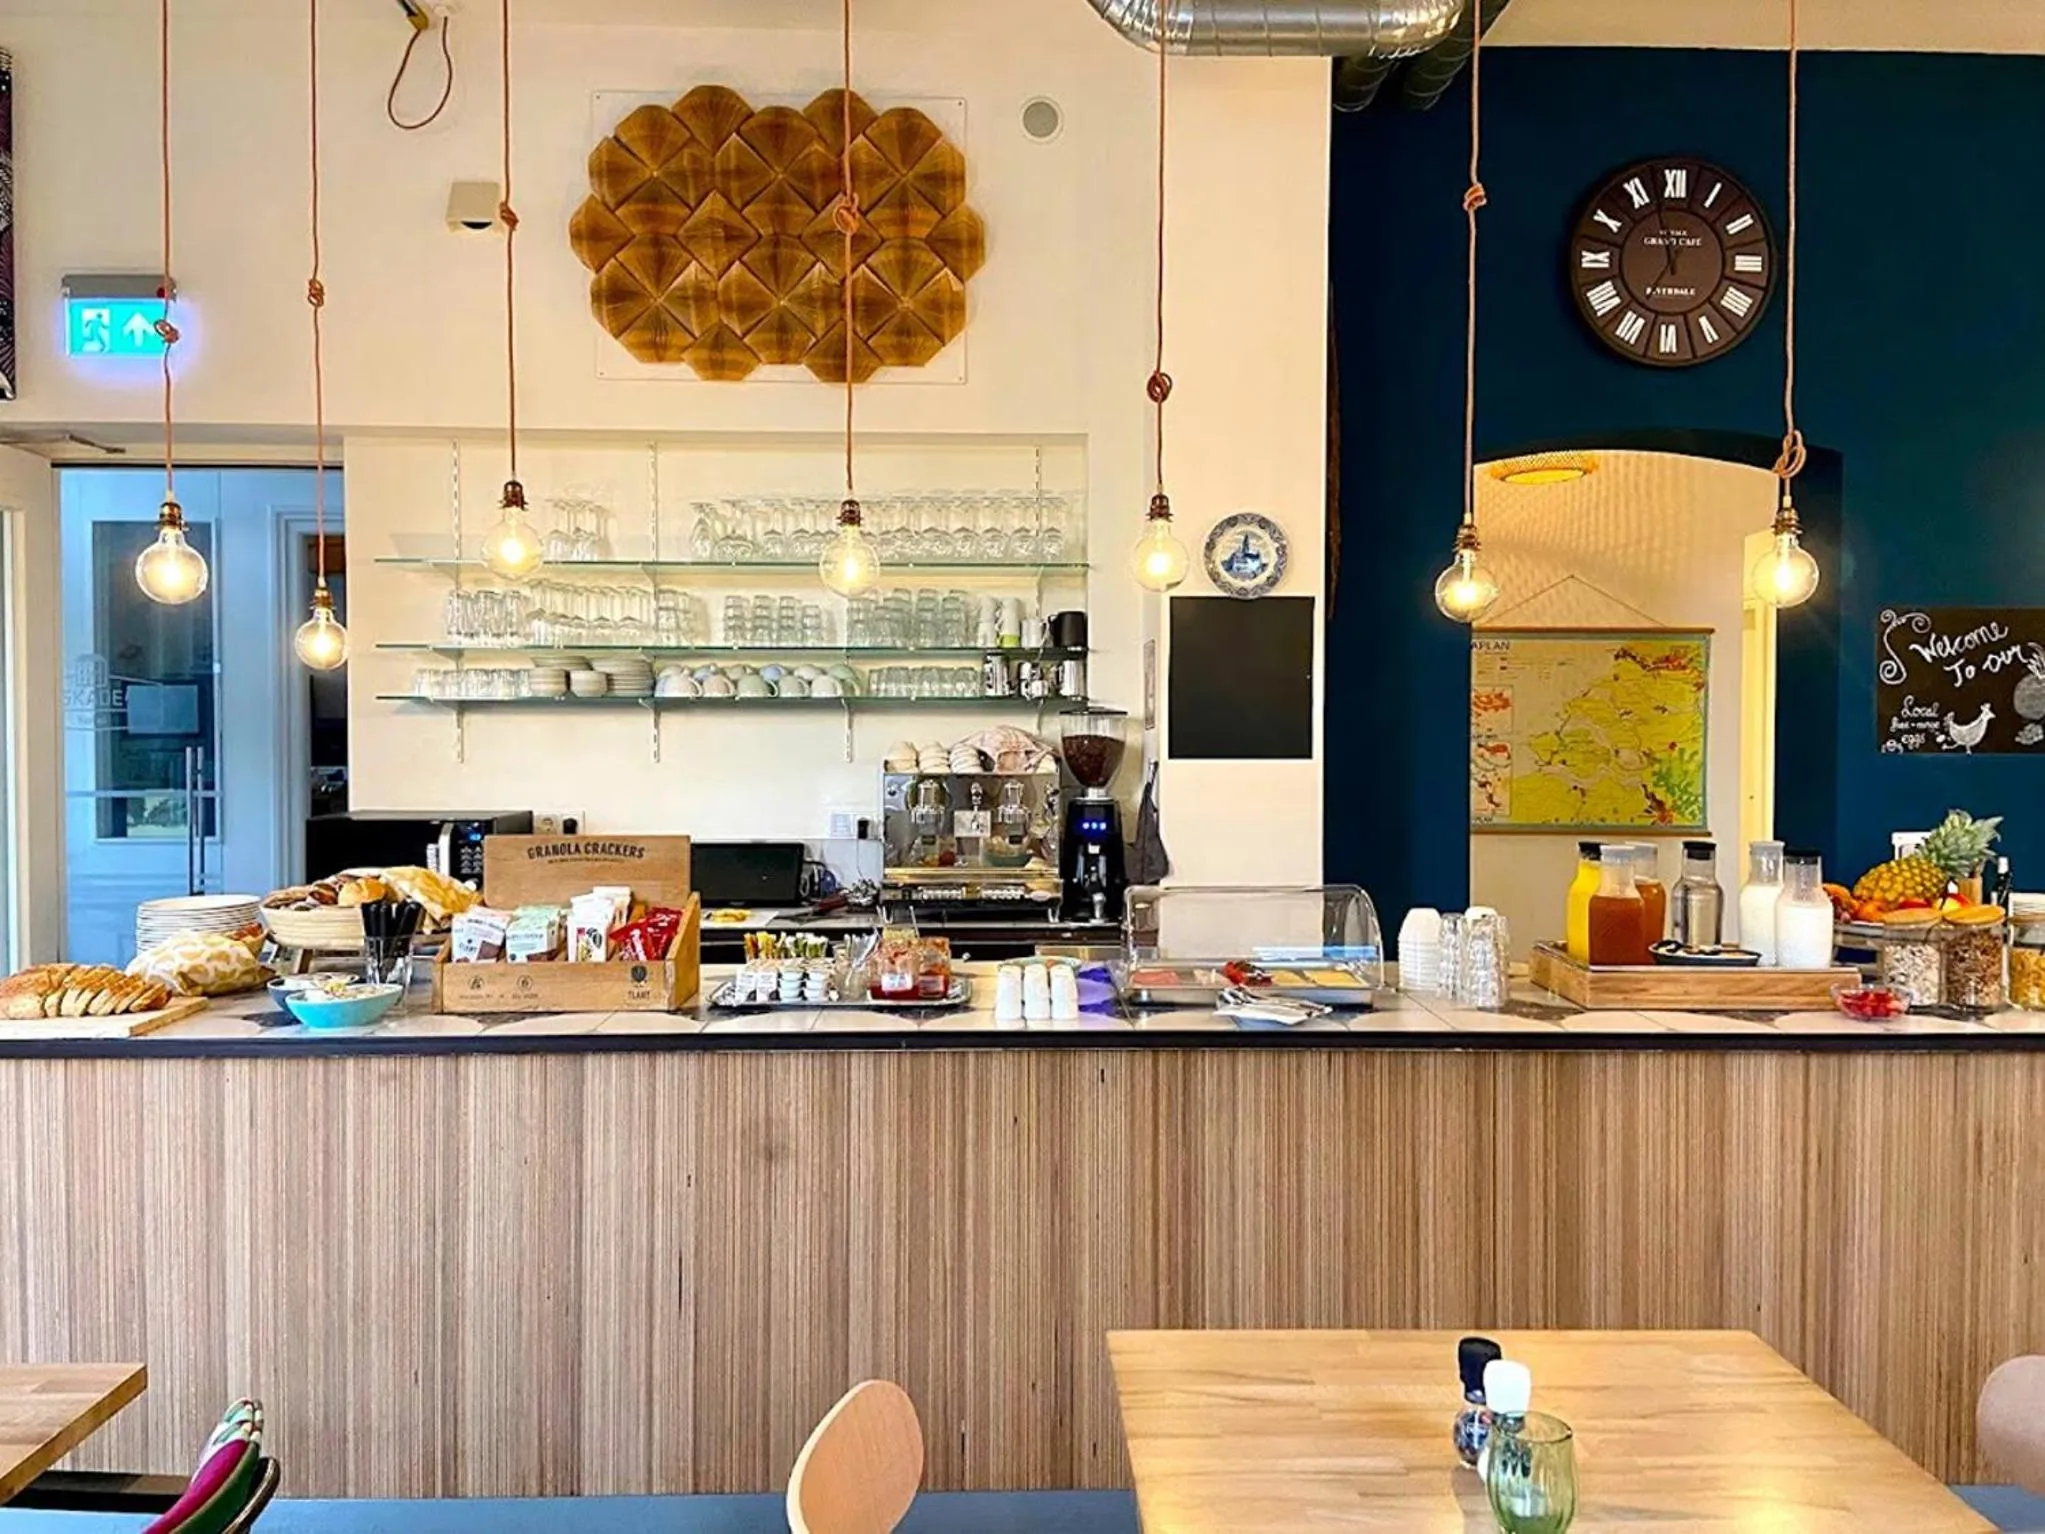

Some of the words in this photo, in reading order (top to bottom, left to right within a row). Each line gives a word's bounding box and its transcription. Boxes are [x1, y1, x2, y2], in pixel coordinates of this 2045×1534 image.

[1623, 177, 1651, 209] XI
[1664, 169, 1687, 199] XII
[1704, 182, 1722, 208] I
[1593, 209, 1623, 233] X
[1726, 213, 1754, 235] II
[1581, 250, 1610, 269] IX
[1734, 254, 1763, 272] III
[1586, 280, 1621, 318] VIII
[1645, 286, 1696, 296] RVERDALE
[1614, 310, 1646, 345] VII
[1660, 324, 1678, 354] VI
[1698, 316, 1719, 344] V
[1909, 621, 2009, 663] Welcome
[1983, 645, 2029, 673] our
[1901, 694, 1940, 718] Local
[527, 843, 581, 860] GRANOLA
[584, 842, 646, 859] CRACKERS
